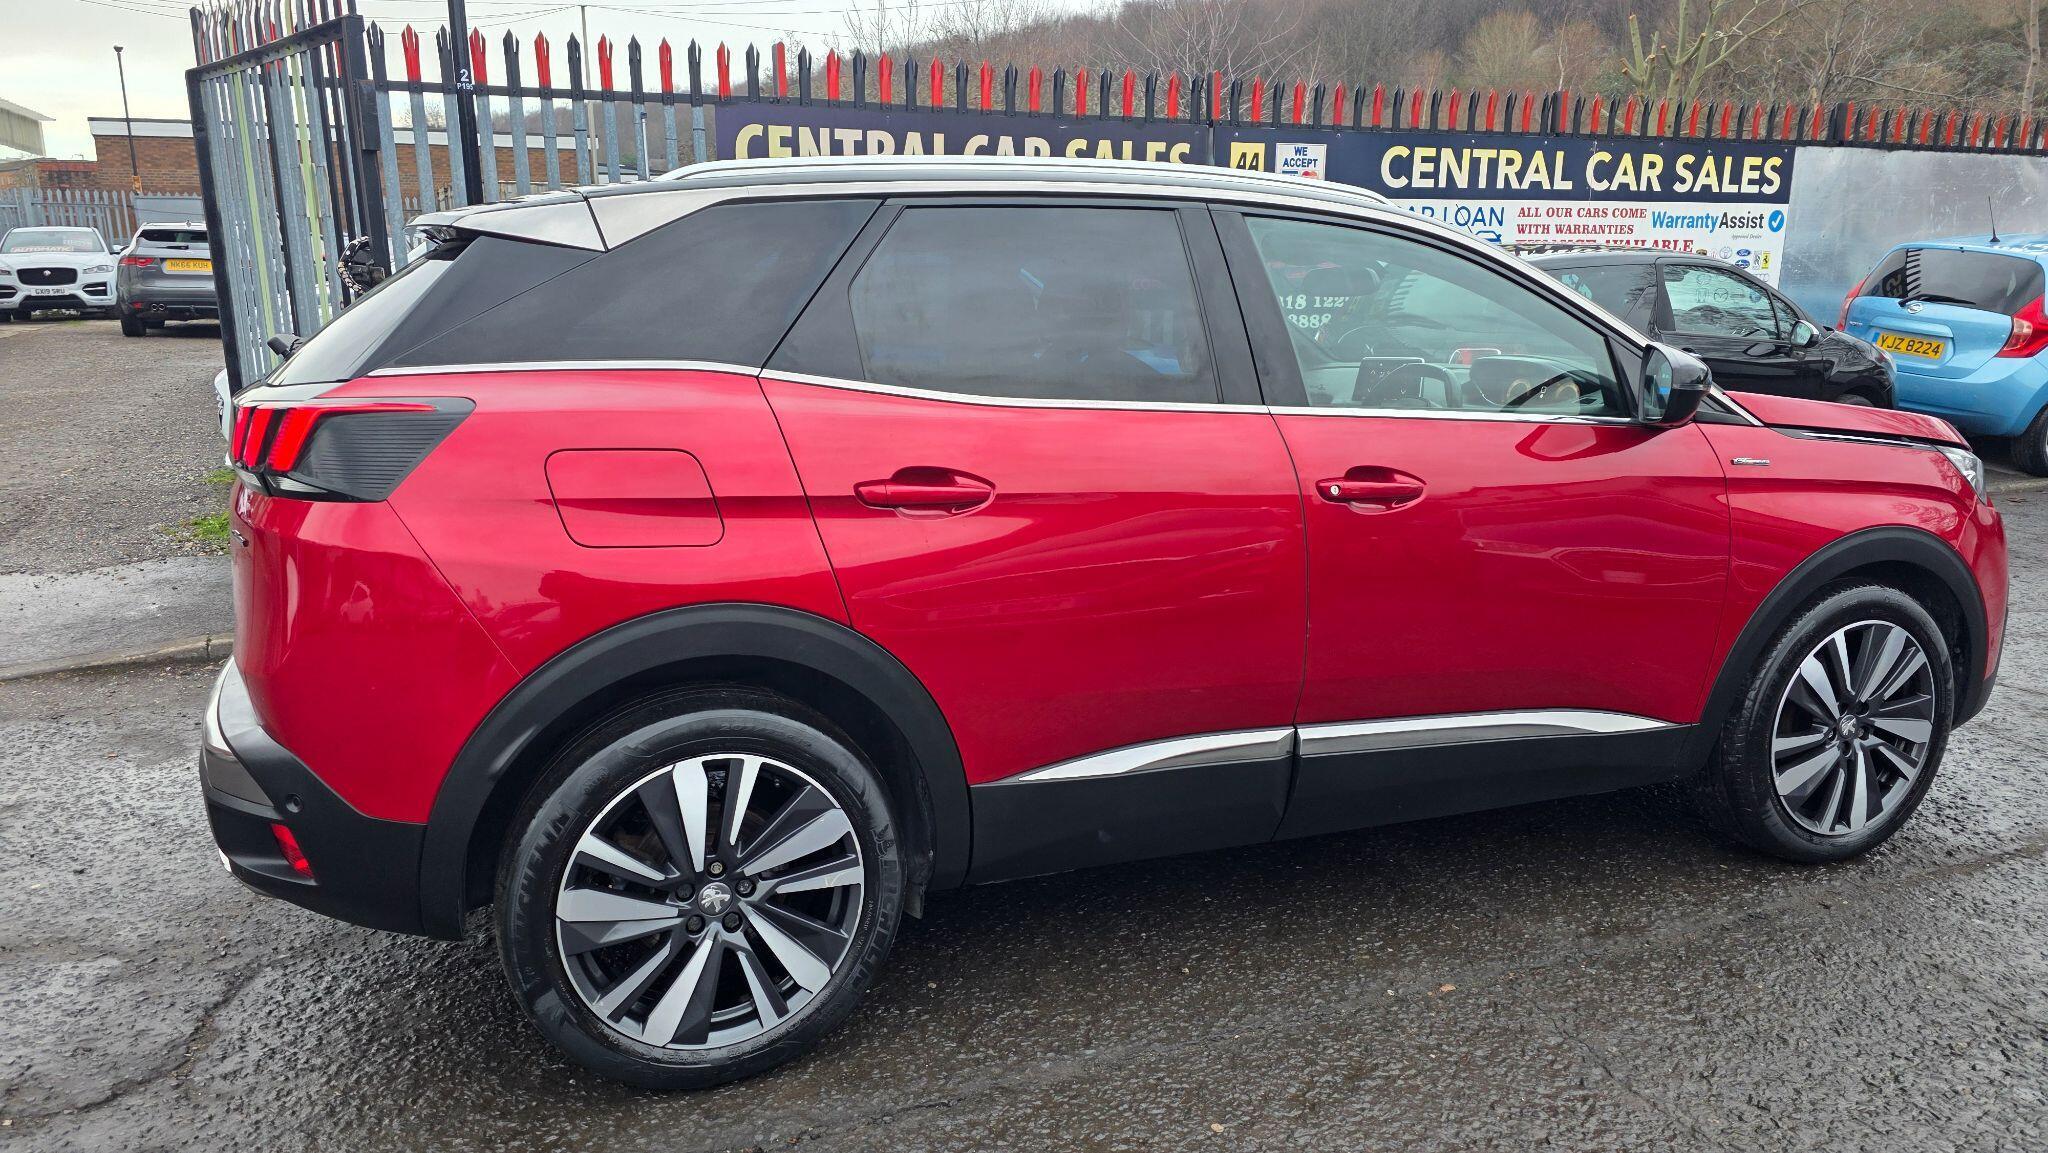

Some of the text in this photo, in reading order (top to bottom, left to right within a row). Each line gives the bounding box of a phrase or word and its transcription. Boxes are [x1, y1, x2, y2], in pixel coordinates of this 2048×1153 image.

[460, 69, 469, 82] 2
[1294, 146, 1308, 157] WE
[1282, 157, 1318, 168] ACCEPT
[1380, 145, 1783, 195] CENTRAL CAR SALES
[1443, 205, 1505, 227] LOAN
[1517, 206, 1648, 219] ALL OUR CARS COME
[1516, 223, 1634, 235] WITH WARRANTIES
[1879, 333, 1941, 357] YJZ 8224
